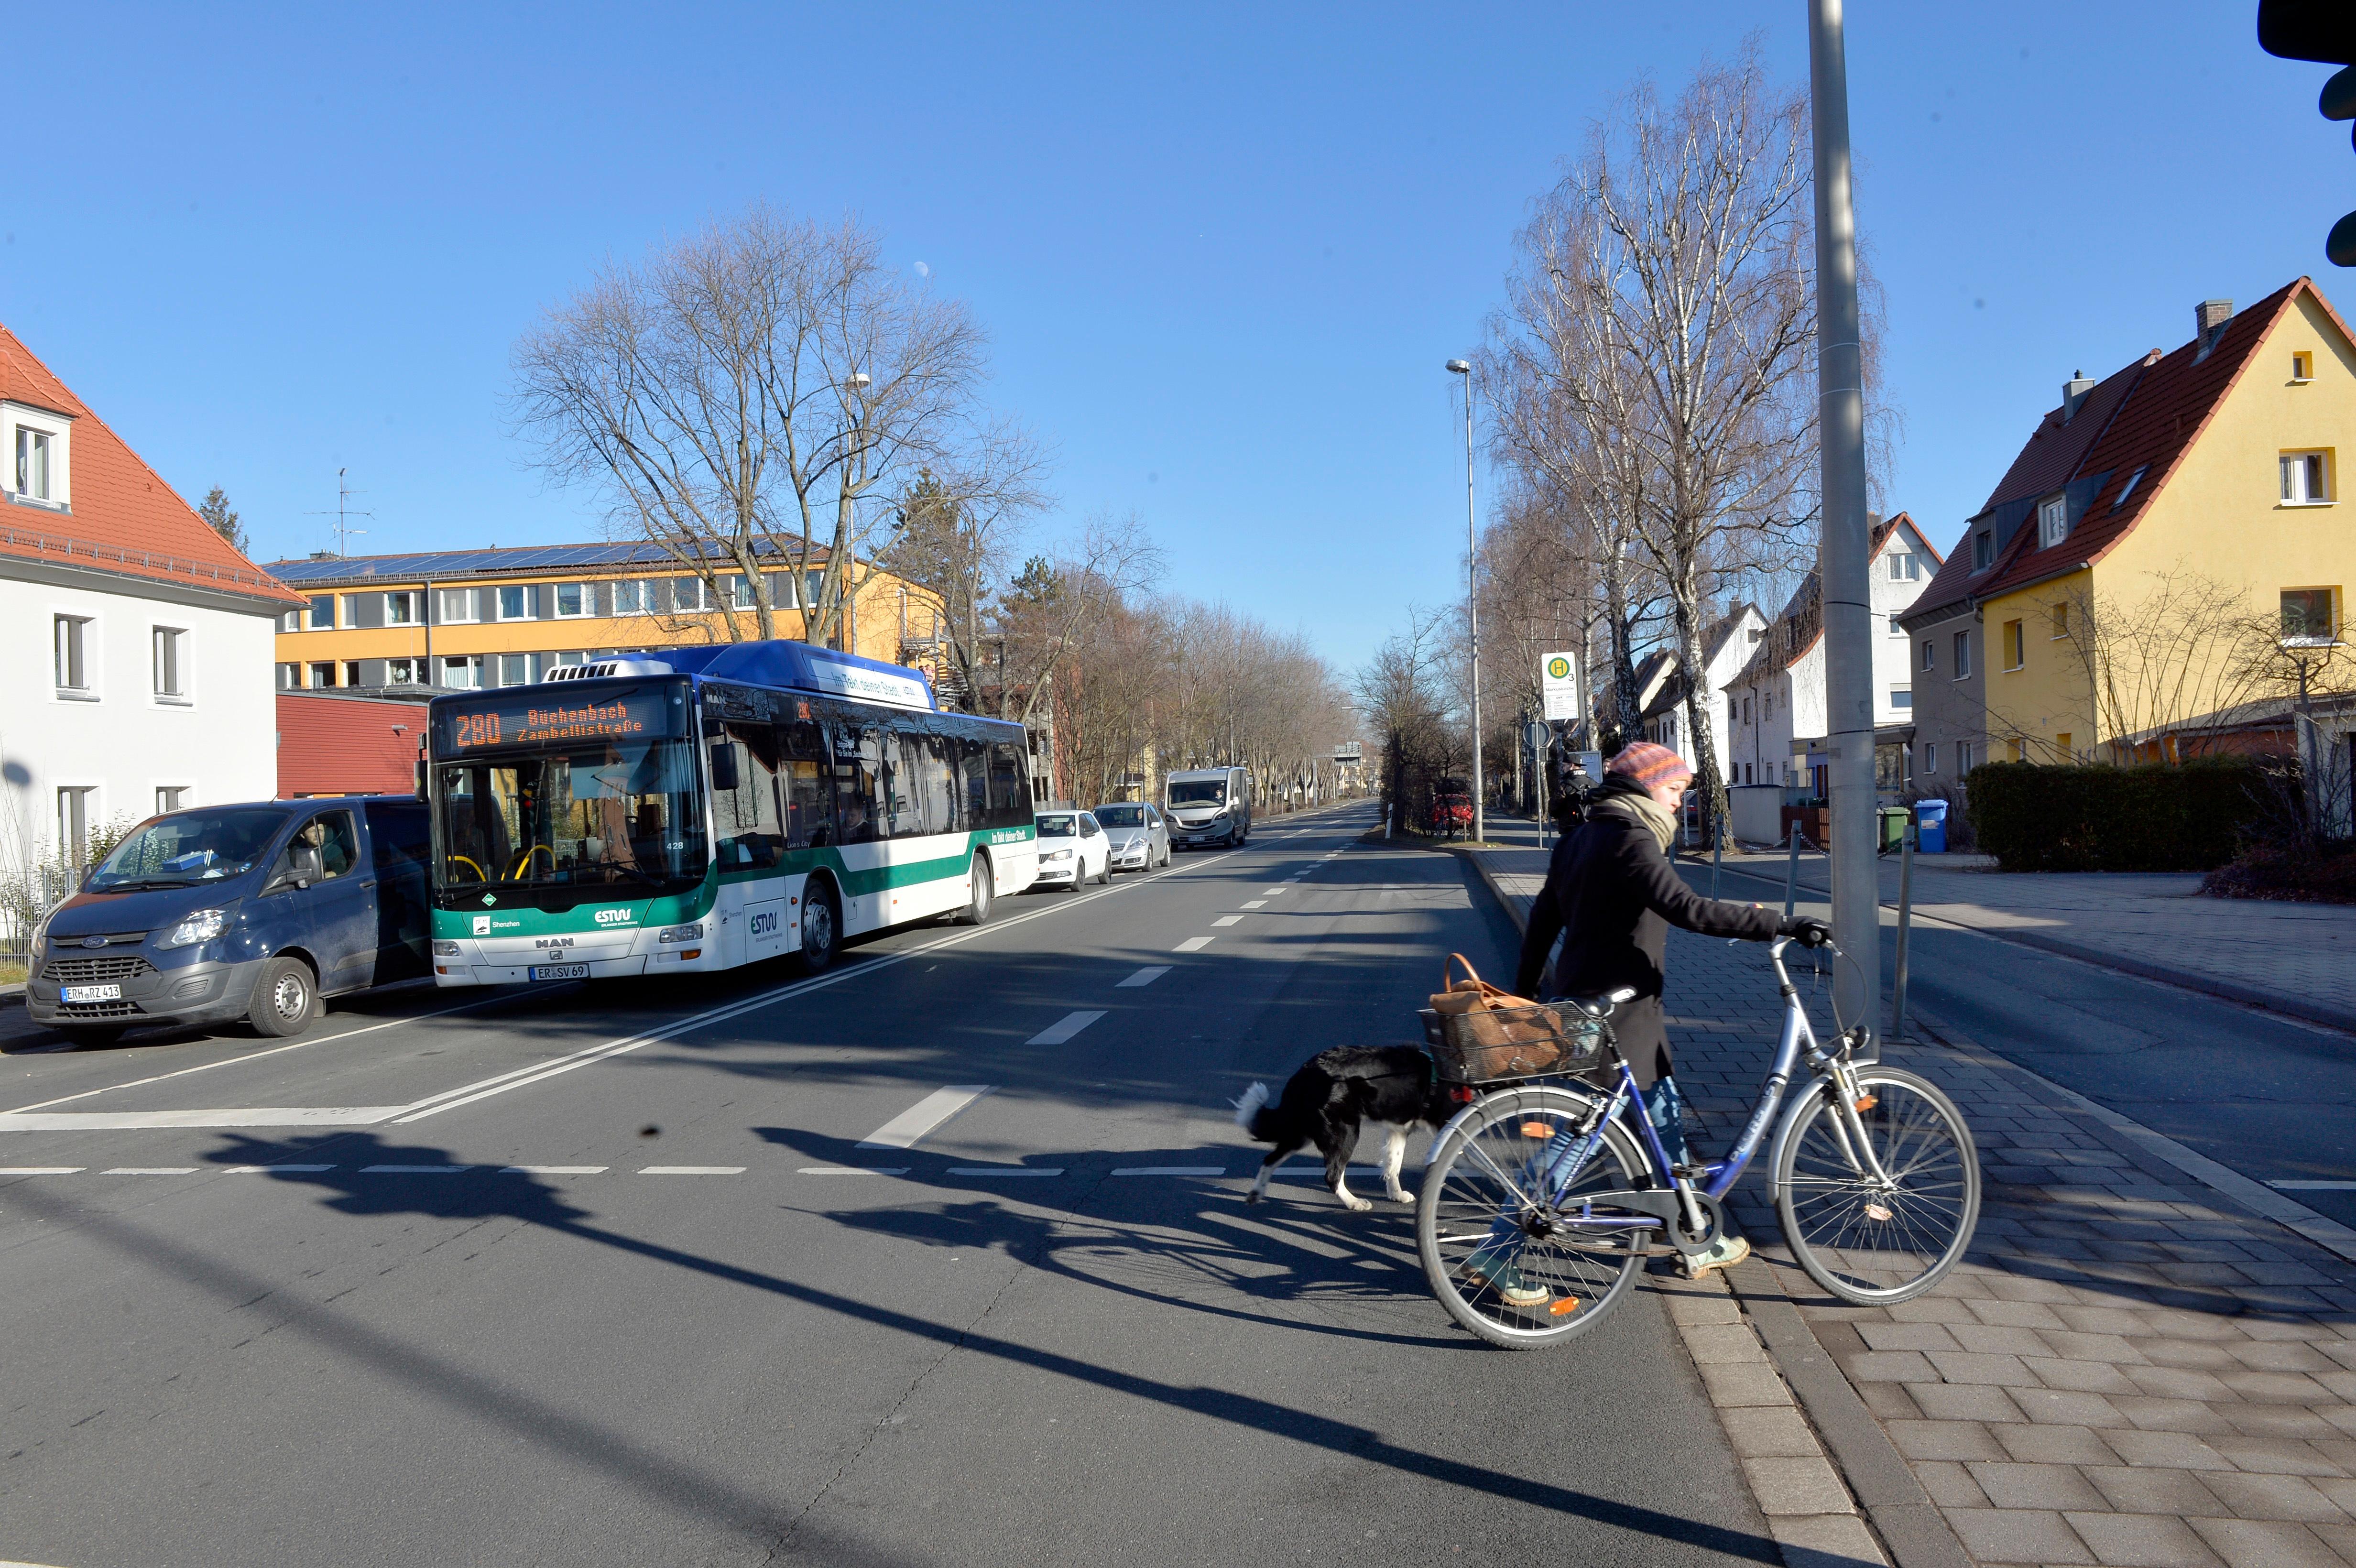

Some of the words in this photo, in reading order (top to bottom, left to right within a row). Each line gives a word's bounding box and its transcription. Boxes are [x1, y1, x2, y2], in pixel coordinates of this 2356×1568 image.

[831, 671, 844, 687] Im
[841, 674, 860, 690] Takt
[860, 678, 882, 693] deiner
[1568, 673, 1574, 682] 3
[706, 694, 727, 705] MAN
[528, 701, 627, 726] Büchenbach
[456, 712, 501, 747] 280
[516, 719, 642, 741] Zambellistraße
[992, 832, 997, 843] Im
[1005, 831, 1016, 842] deiner
[666, 842, 684, 850] 428
[801, 840, 810, 849] City
[594, 908, 631, 923] ESTW
[751, 911, 777, 935] ESTW
[535, 938, 574, 948] MAN
[538, 968, 551, 978] ER
[557, 967, 569, 977] SV
[572, 966, 584, 976] 69
[67, 989, 84, 1000] ERH
[89, 988, 101, 998] RZ
[103, 986, 119, 997] 413
